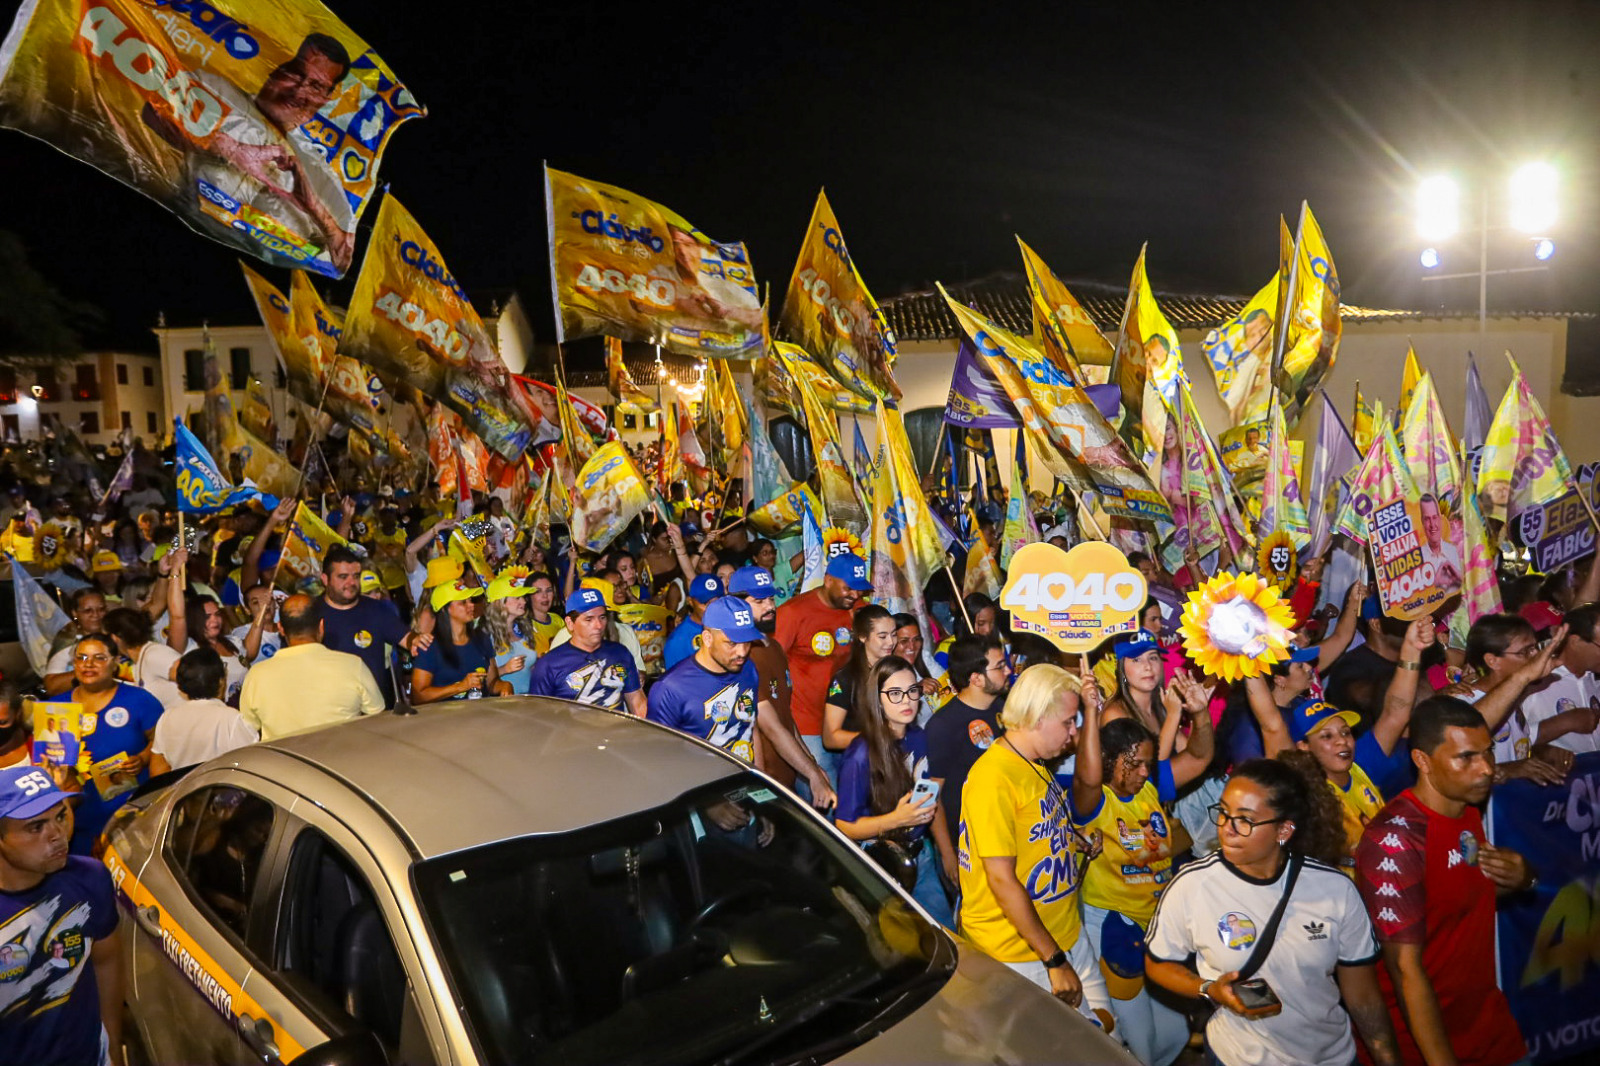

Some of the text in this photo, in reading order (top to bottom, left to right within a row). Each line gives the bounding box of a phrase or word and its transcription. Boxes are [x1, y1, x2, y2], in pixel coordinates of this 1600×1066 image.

[80, 6, 223, 138] 4040
[304, 119, 339, 148] 40
[250, 228, 308, 261] VIDAS
[580, 209, 664, 253] Cláudio
[576, 264, 675, 307] 4040
[376, 291, 470, 361] 4040
[1375, 502, 1405, 527] ESSE
[1522, 508, 1543, 534] 55
[1380, 518, 1412, 545] VOTO
[829, 542, 850, 558] 55
[1271, 547, 1289, 563] 55
[1382, 532, 1419, 562] SALVA
[854, 566, 864, 578] 55
[1385, 549, 1422, 579] VIDAS
[754, 572, 770, 586] 55
[1005, 572, 1143, 612] 4040
[1389, 562, 1436, 604] 4040
[582, 591, 598, 604] 55
[734, 610, 751, 626] 55
[1076, 620, 1100, 628] VIDAS
[1058, 630, 1092, 639] Cláudio
[15, 771, 51, 796] 55
[1520, 875, 1600, 992] 4
[163, 929, 232, 1020] TÁXI FRETAMENTO
